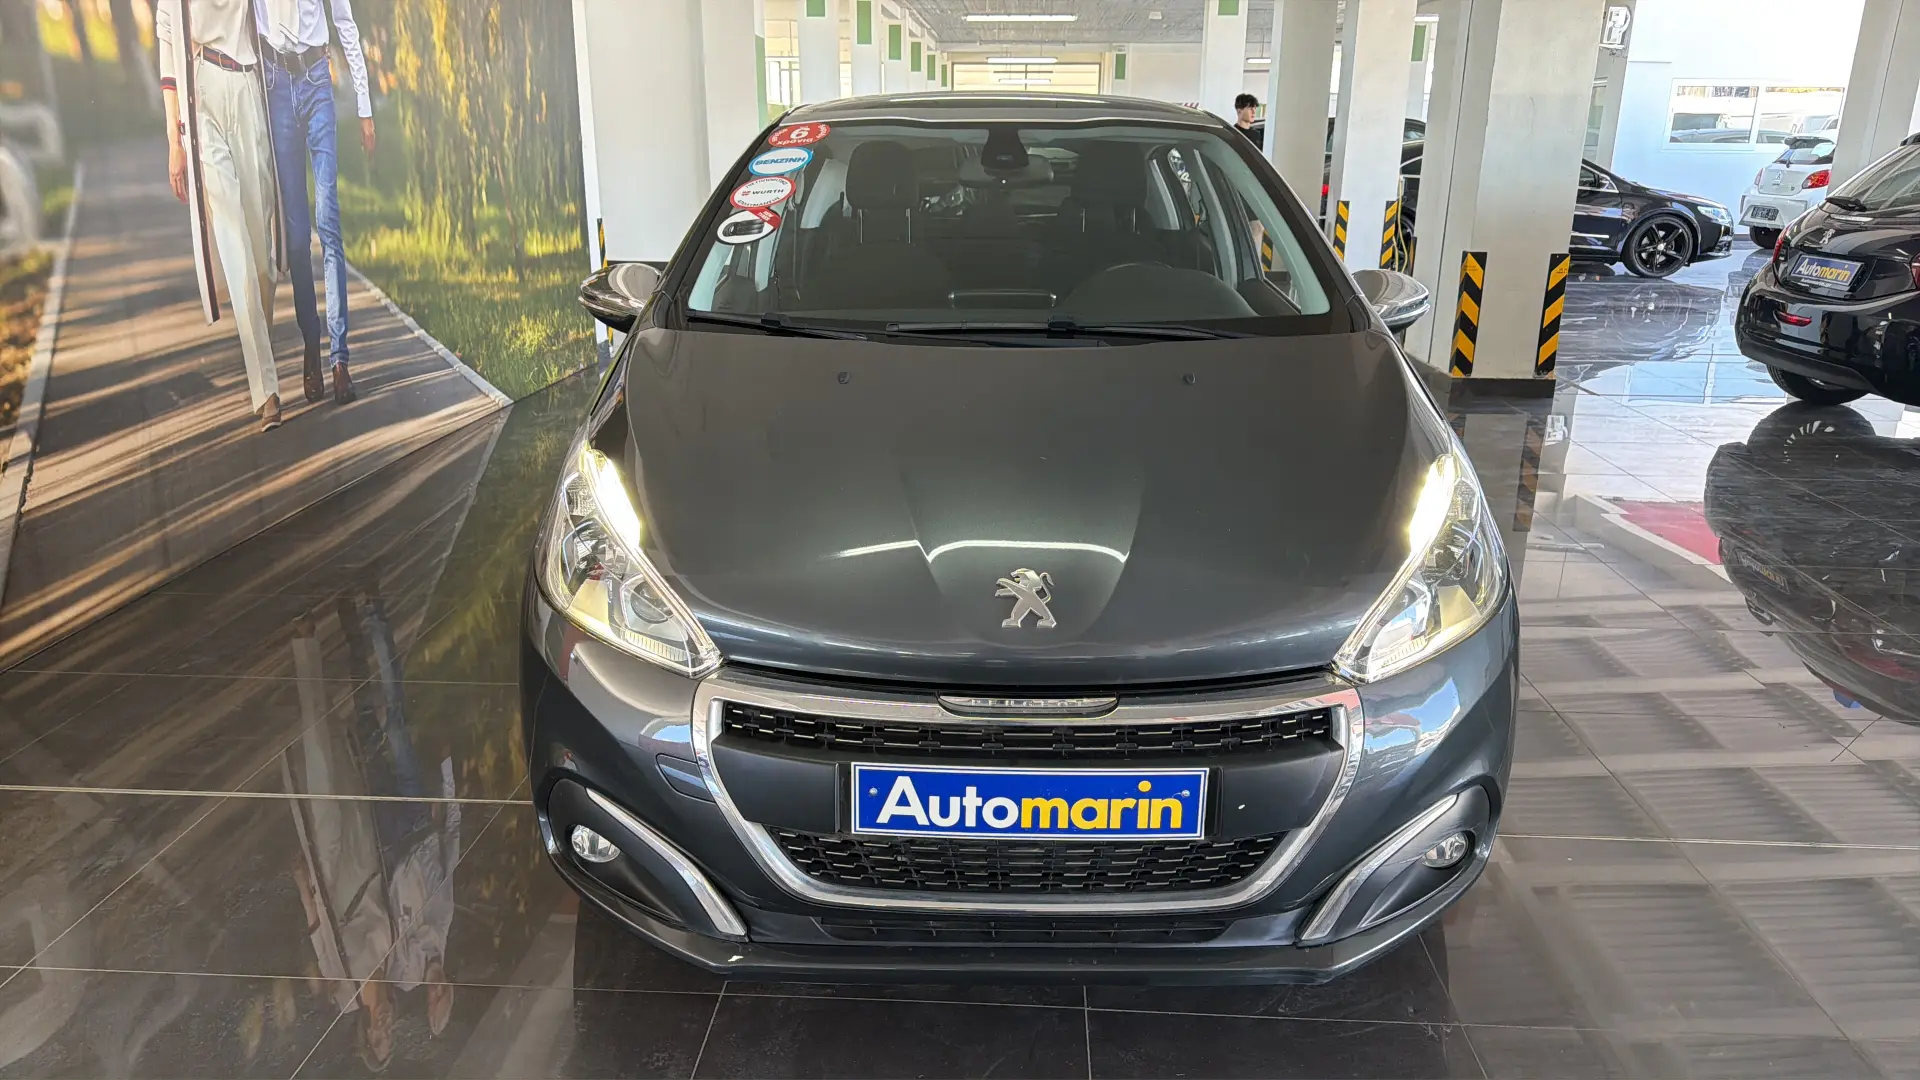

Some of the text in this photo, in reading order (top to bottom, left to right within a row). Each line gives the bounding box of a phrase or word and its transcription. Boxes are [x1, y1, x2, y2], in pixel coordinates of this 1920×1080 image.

[789, 126, 811, 139] 6
[1795, 258, 1851, 281] Automarin
[876, 775, 1183, 830] Automarin
